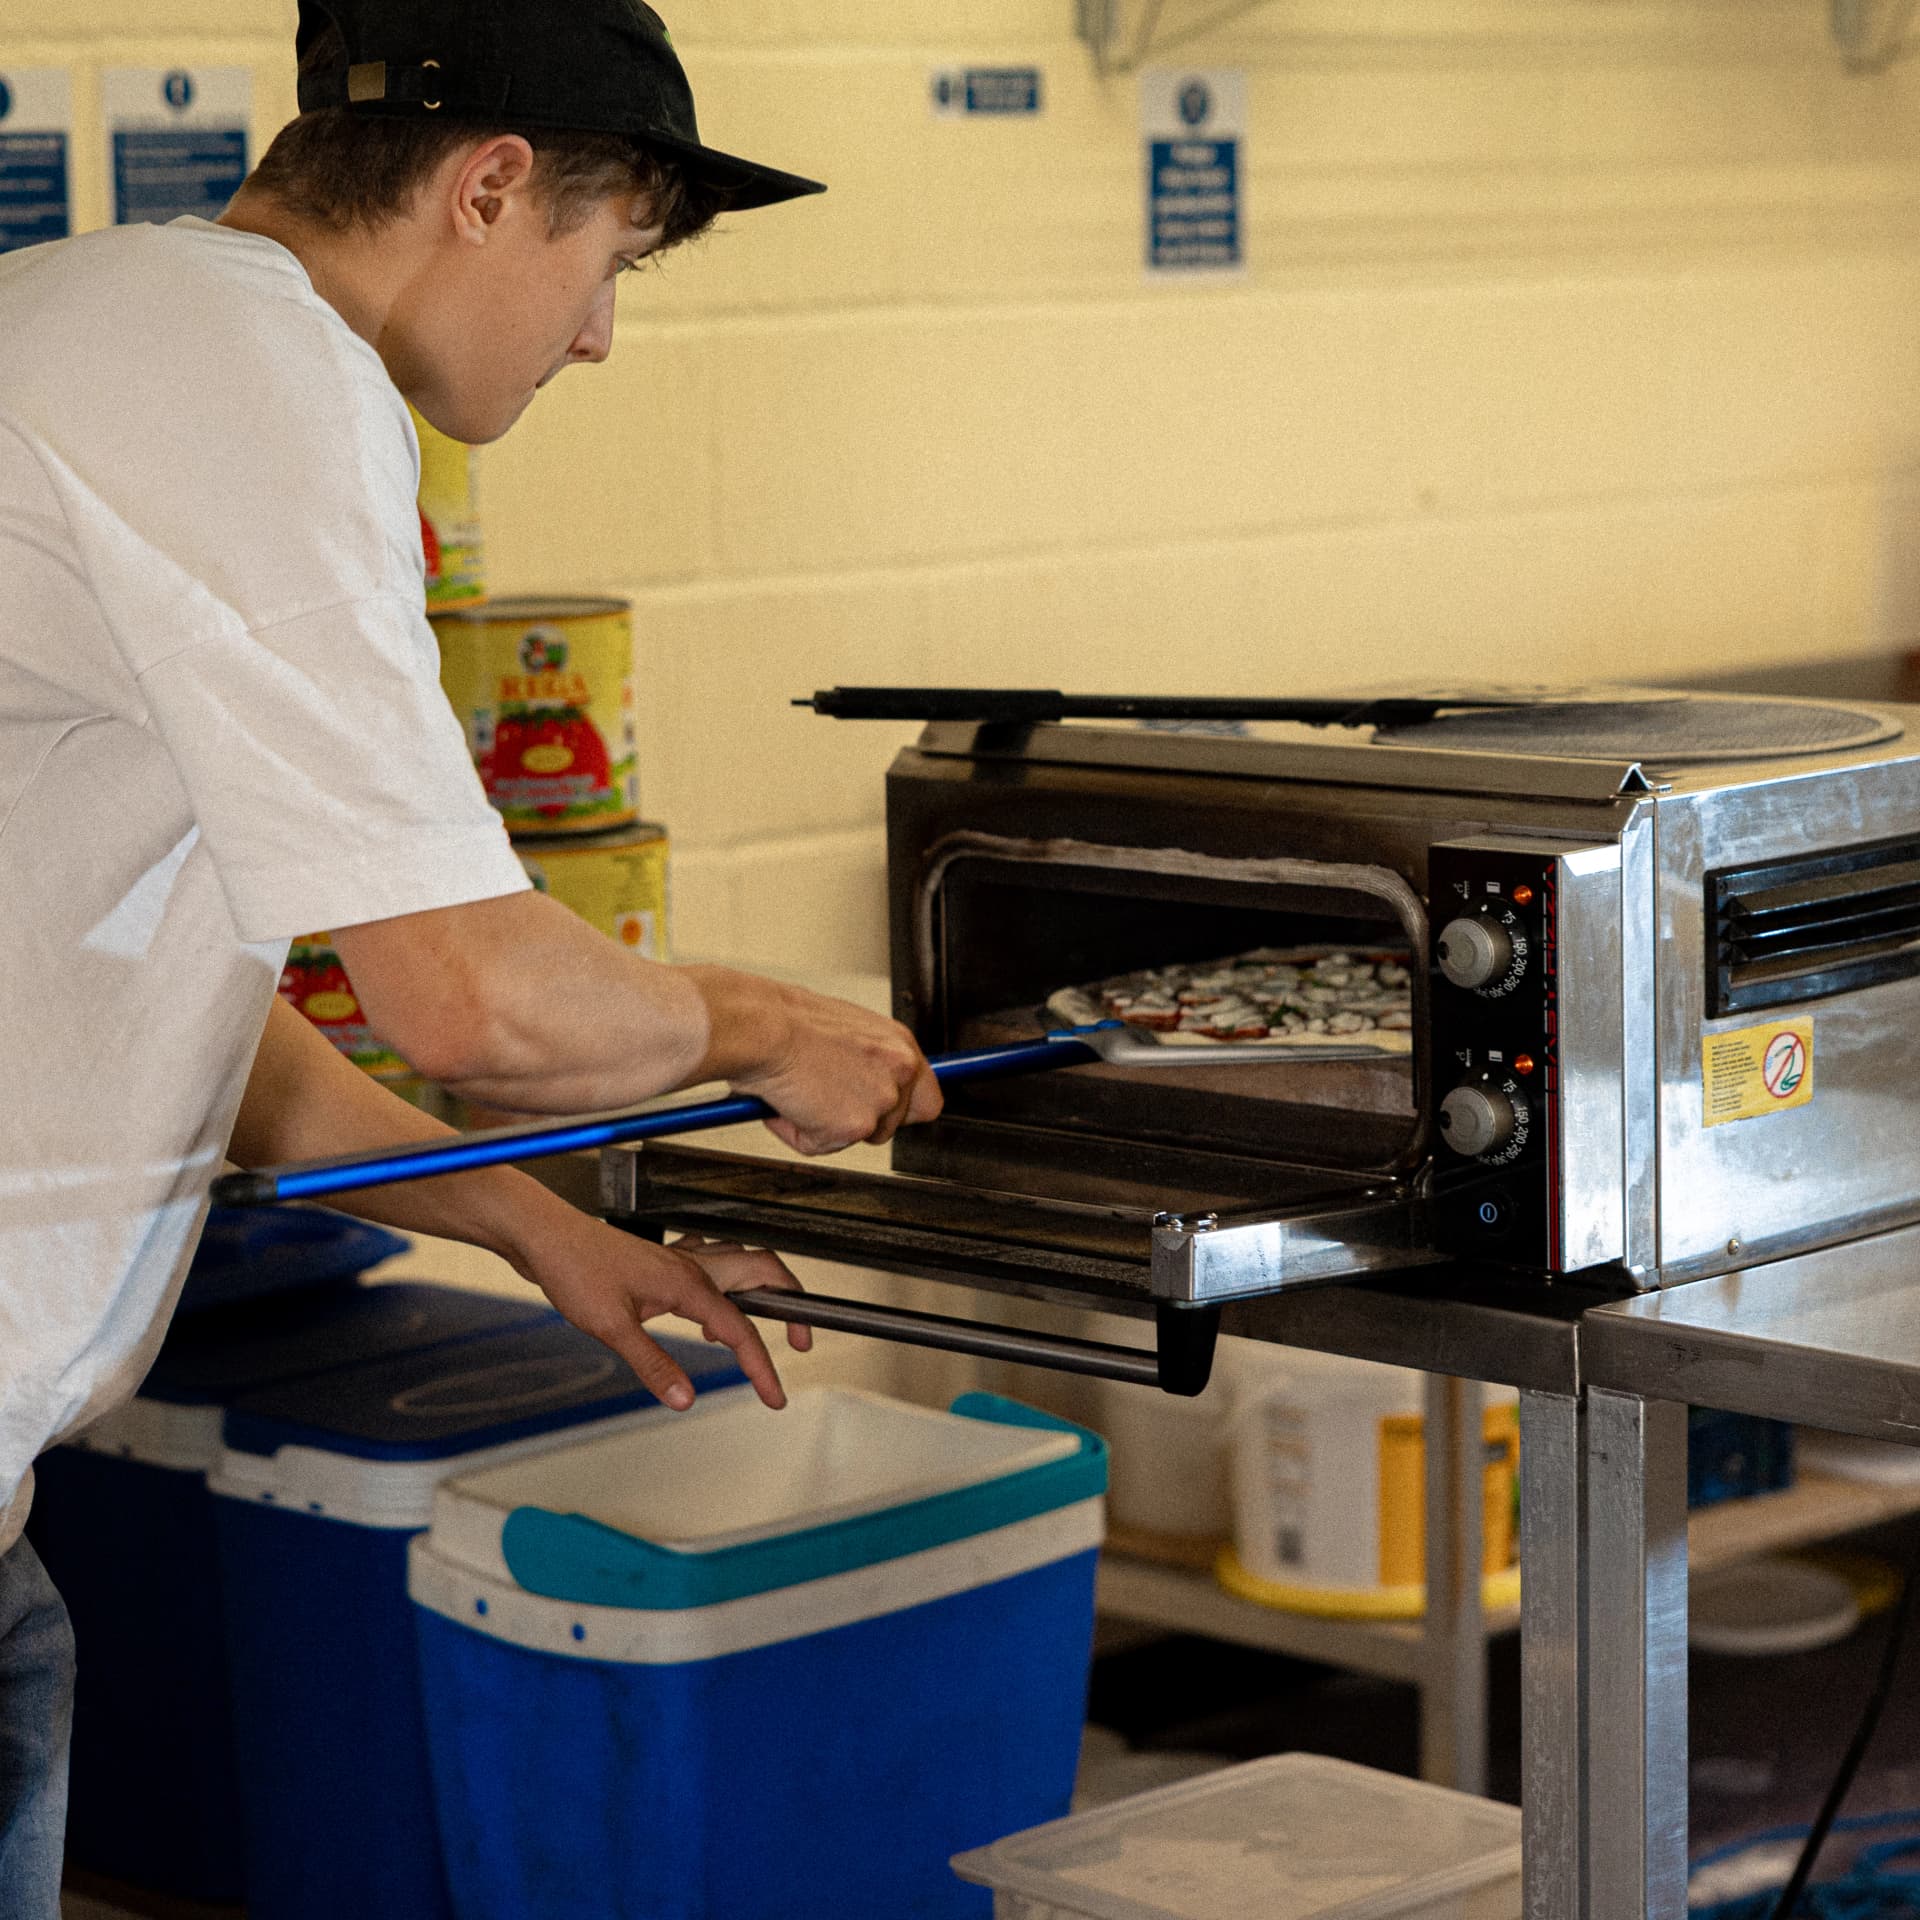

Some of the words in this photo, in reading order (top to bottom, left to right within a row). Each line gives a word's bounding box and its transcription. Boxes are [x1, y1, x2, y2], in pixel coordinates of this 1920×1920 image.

[1542, 862, 1556, 975] PIZZA
[1515, 937, 1528, 955] 150
[1514, 958, 1528, 976] 200
[1503, 975, 1521, 992] 250
[1503, 1078, 1518, 1093] 75
[1517, 1105, 1530, 1124] 150
[1515, 1126, 1529, 1145] 200
